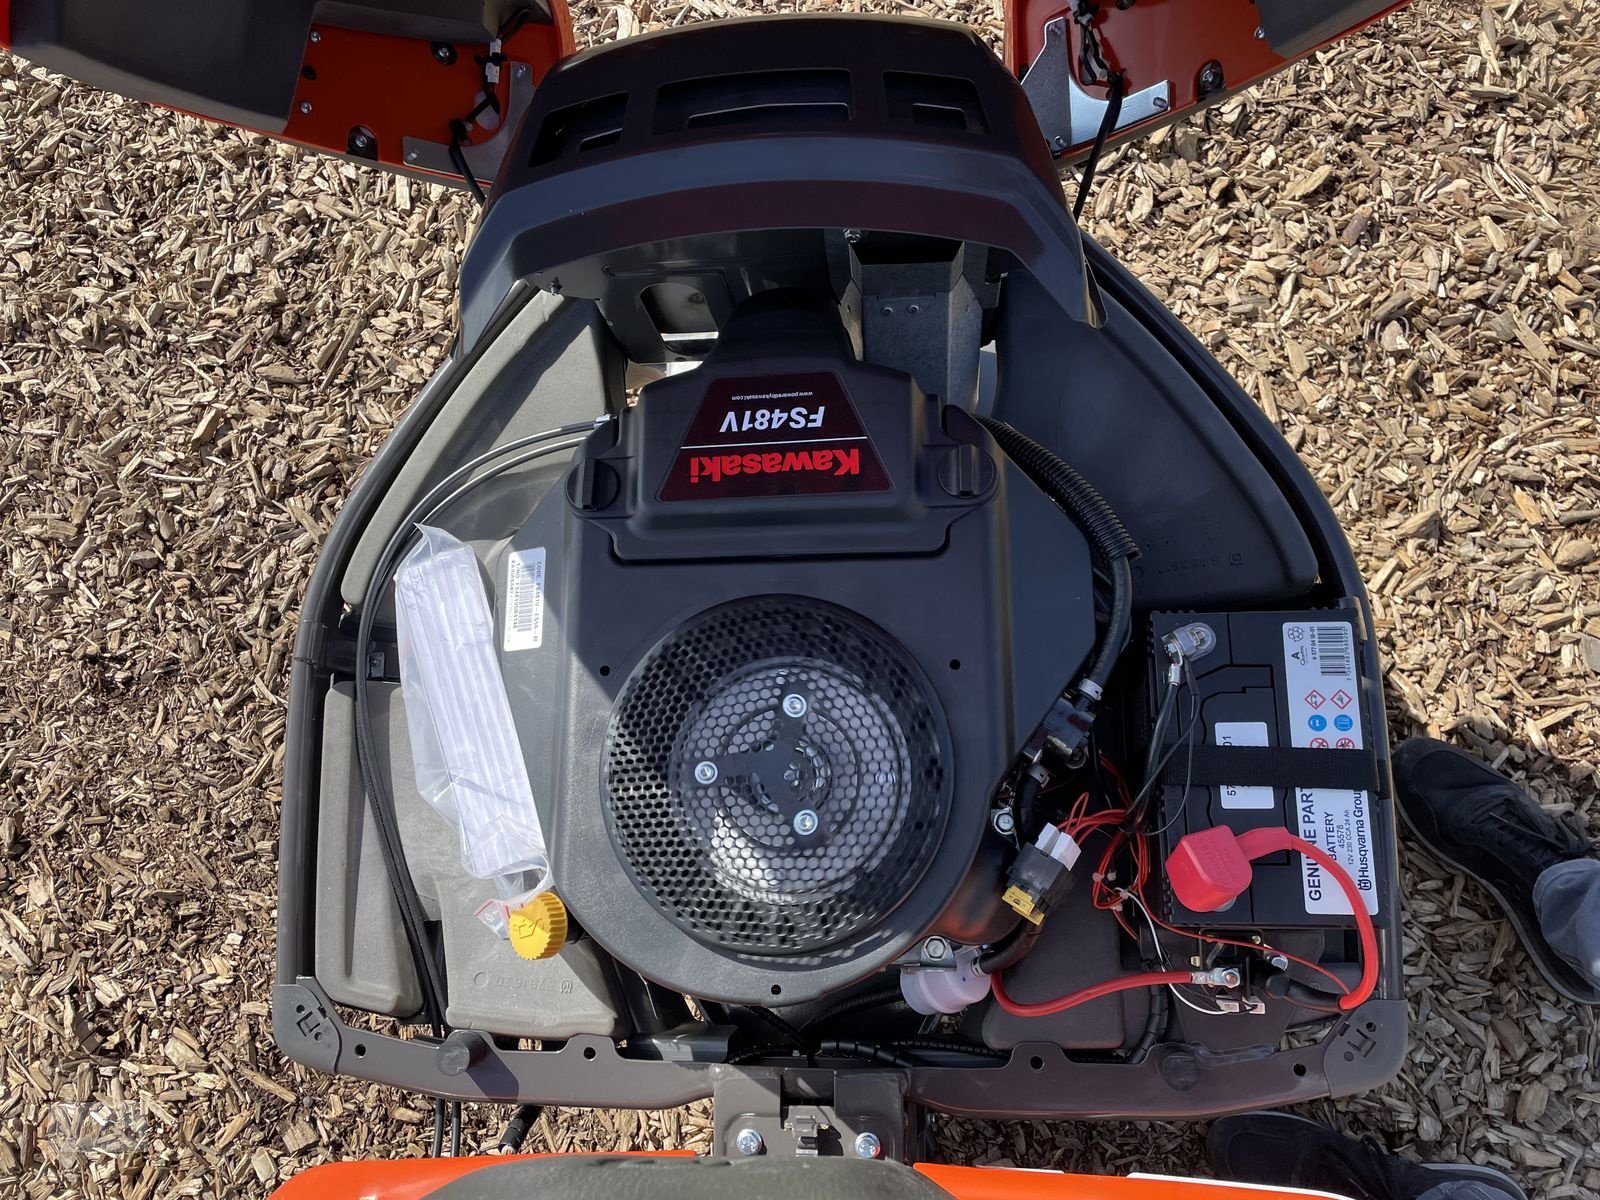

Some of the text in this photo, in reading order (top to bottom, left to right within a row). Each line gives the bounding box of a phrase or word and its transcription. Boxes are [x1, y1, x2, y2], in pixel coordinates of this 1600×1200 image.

[731, 391, 813, 401] www.poweredbykawasaki.com
[719, 406, 825, 433] FS481V
[690, 448, 860, 483] Kawasaki
[1291, 651, 1300, 660] A
[1324, 811, 1337, 861] BATTERY
[1336, 824, 1345, 849] 45578
[1353, 790, 1369, 878] Husqvarna Grou
[1304, 829, 1322, 901] GENUNE
